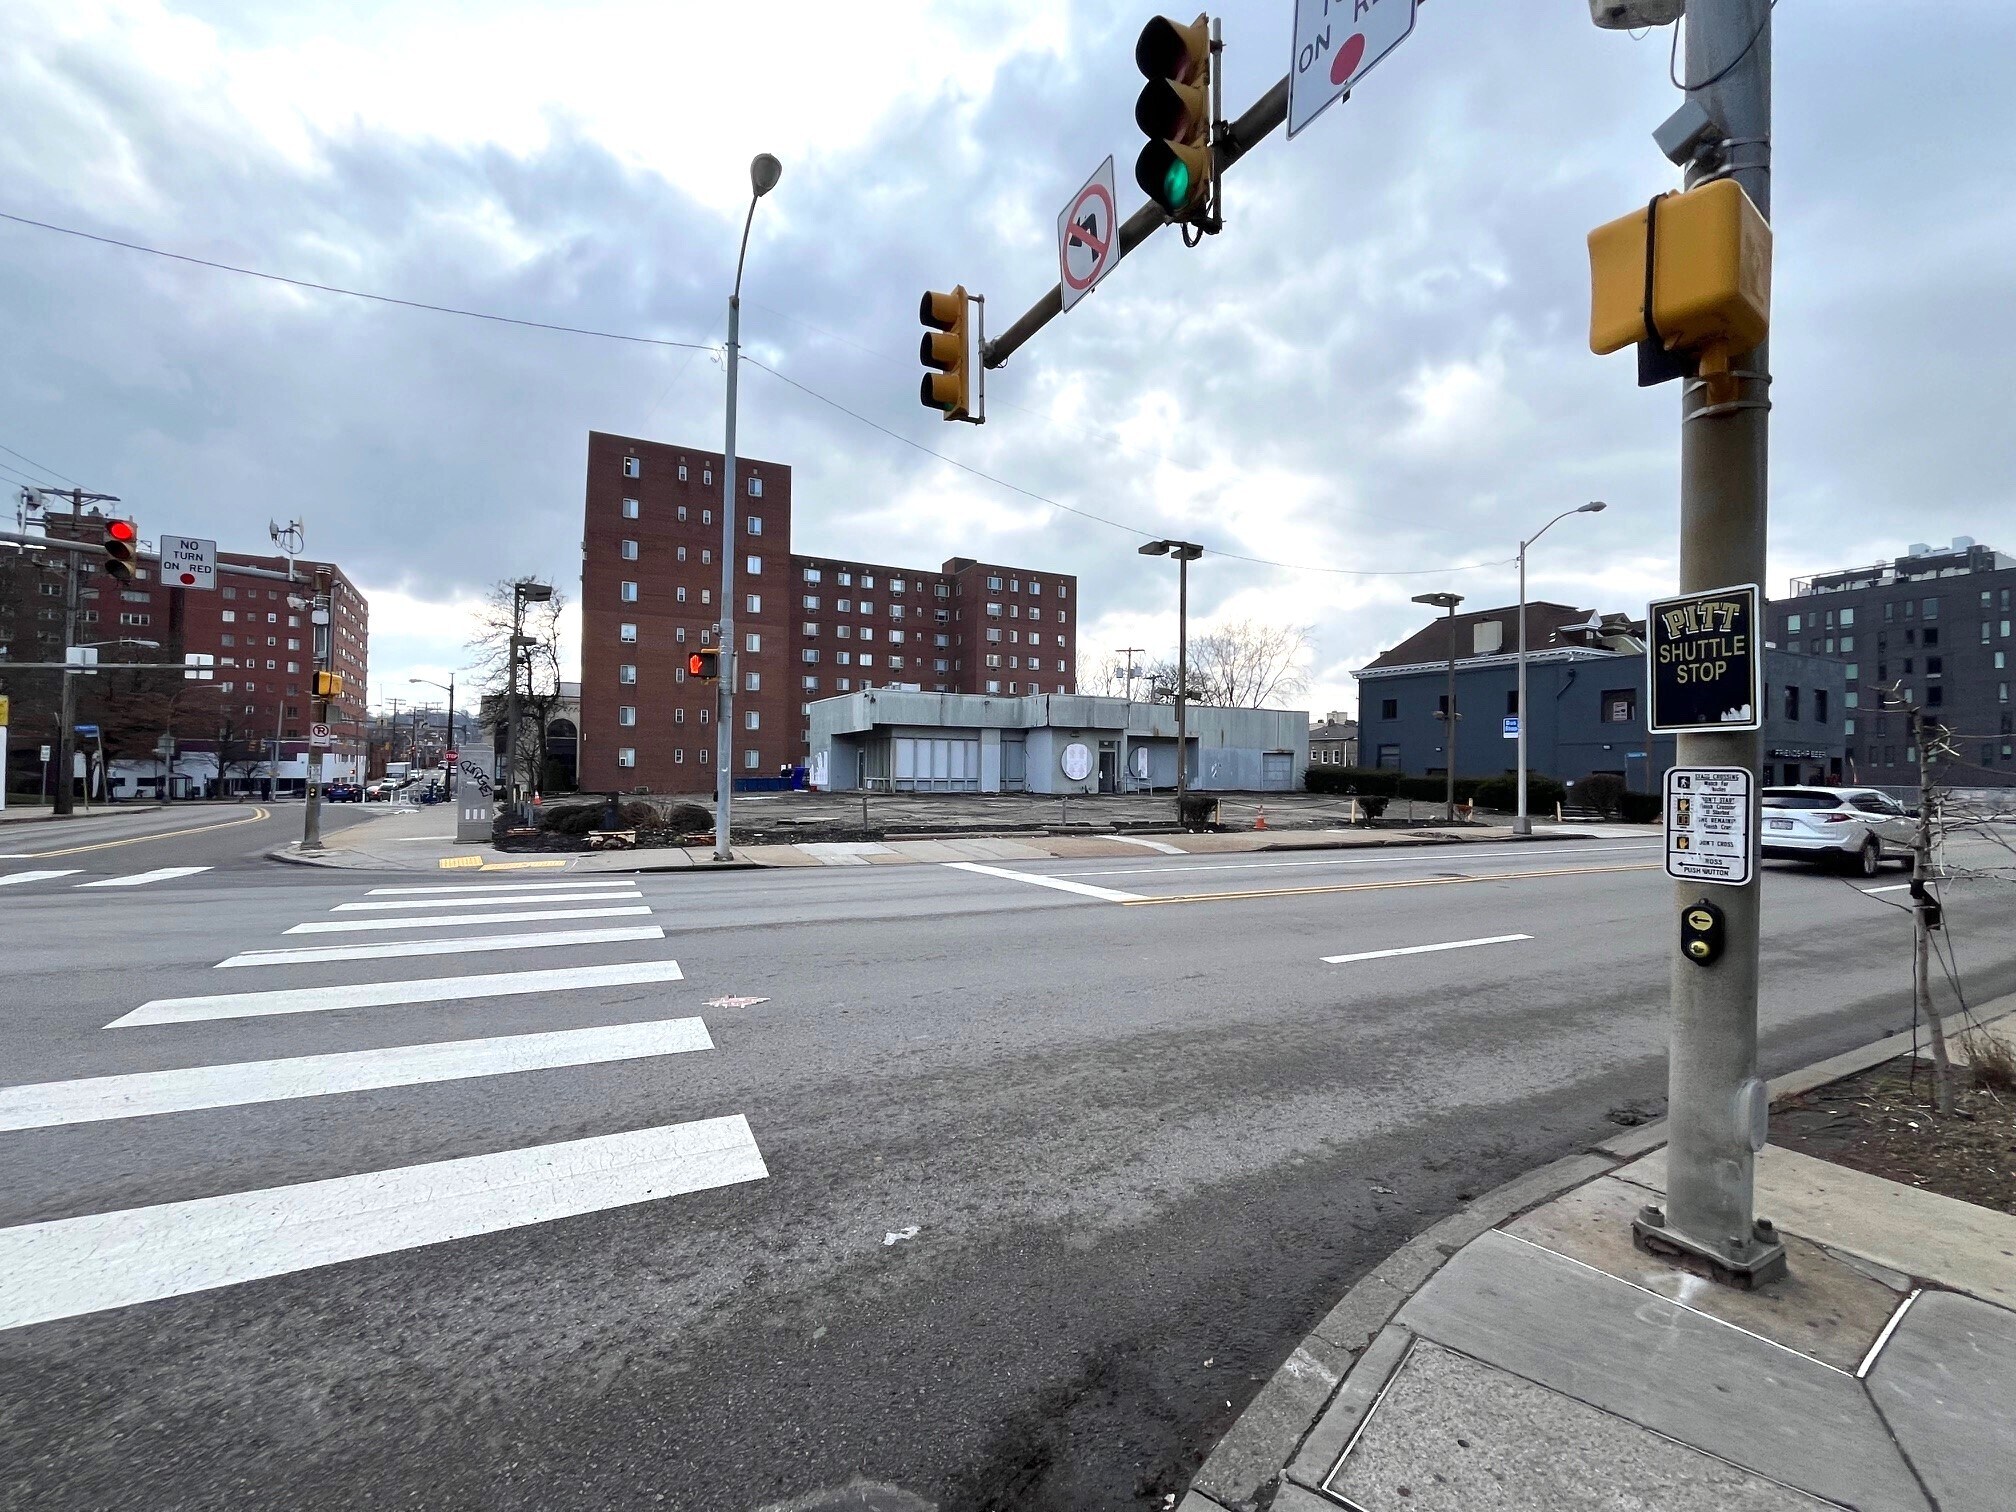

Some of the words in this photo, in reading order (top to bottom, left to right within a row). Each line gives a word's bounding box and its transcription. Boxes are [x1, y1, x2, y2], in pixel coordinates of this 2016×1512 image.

[1299, 24, 1330, 73] ON
[180, 540, 199, 550] NO
[173, 551, 203, 561] TURN
[164, 561, 180, 570] ON
[189, 564, 212, 574] RED
[1661, 601, 1741, 640] PITT
[1660, 635, 1746, 664] SHUTTLE
[1677, 661, 1728, 684] STOP
[1683, 866, 1701, 874] PUSH
